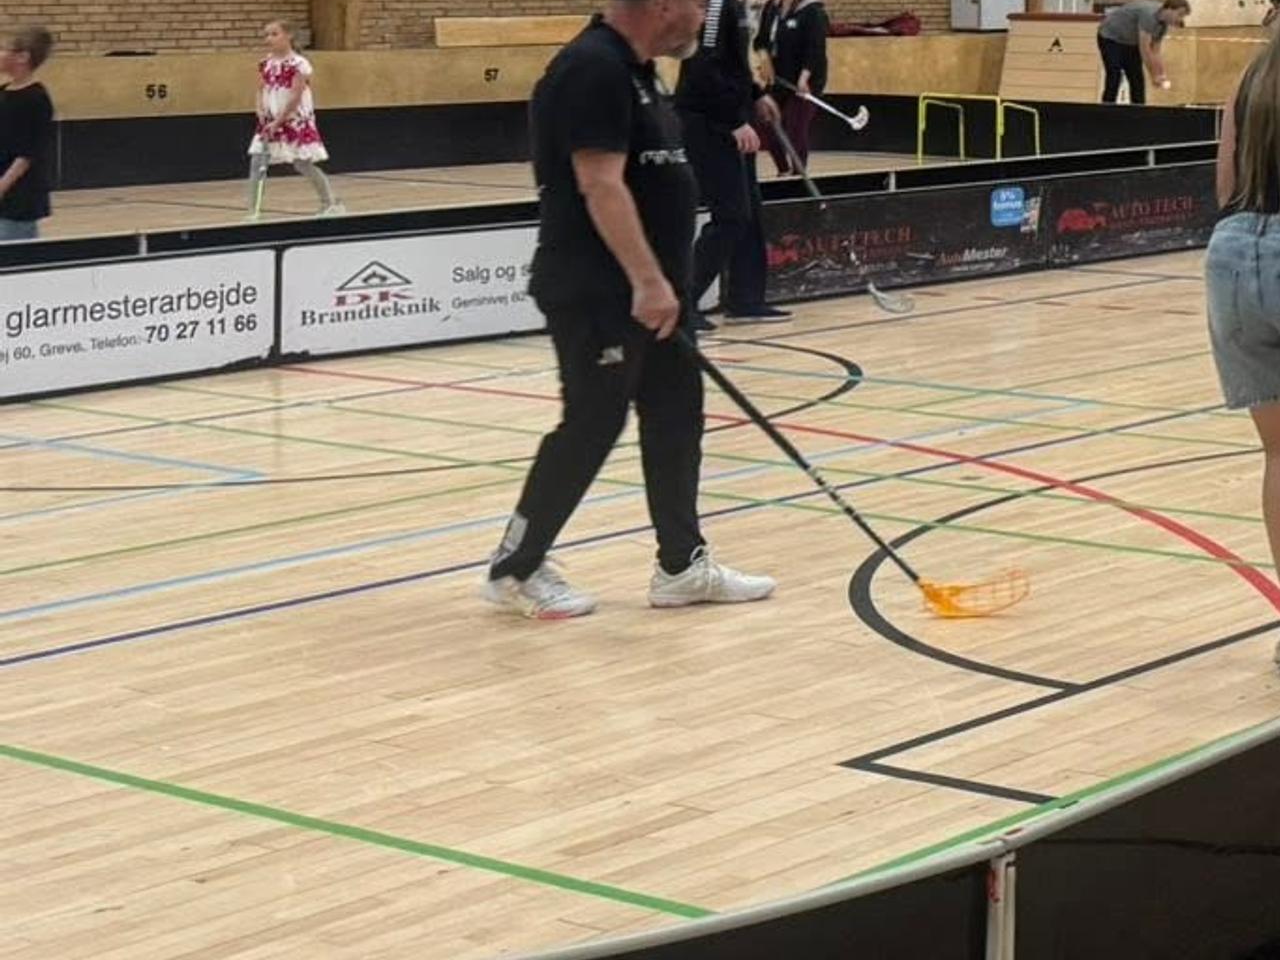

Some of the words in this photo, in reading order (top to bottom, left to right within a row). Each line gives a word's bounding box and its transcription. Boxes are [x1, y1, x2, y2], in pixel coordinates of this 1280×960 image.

[484, 68, 499, 82] 57
[145, 84, 167, 99] 56
[452, 266, 490, 284] Salg
[495, 265, 516, 282] og
[5, 282, 258, 338] glarmesterarbejde
[301, 299, 441, 326] Brandteknik
[144, 323, 169, 344] 70
[176, 320, 199, 339] 27
[207, 317, 226, 336] 11
[234, 313, 257, 332] 66
